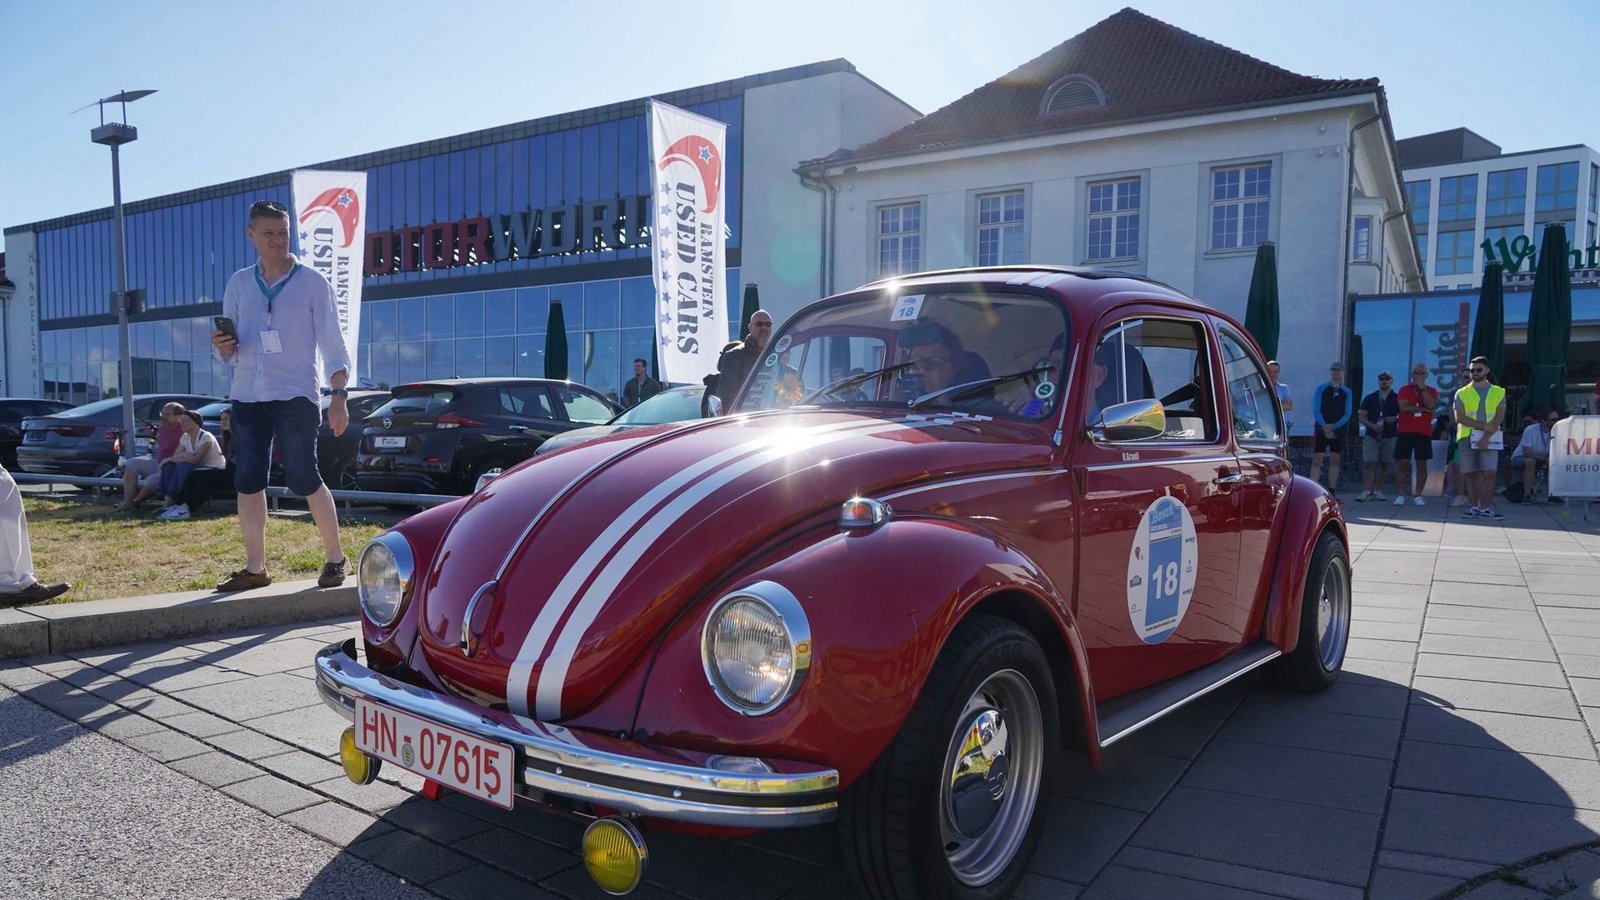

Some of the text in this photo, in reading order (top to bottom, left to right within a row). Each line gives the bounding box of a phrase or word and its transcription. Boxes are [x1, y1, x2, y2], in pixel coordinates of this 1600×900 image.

[675, 182, 699, 355] USED CARS
[700, 222, 715, 320] RAMSTEIN
[1480, 235, 1600, 272] Wiht
[899, 306, 915, 317] 18
[1567, 438, 1600, 455] M
[1152, 561, 1178, 600] 18
